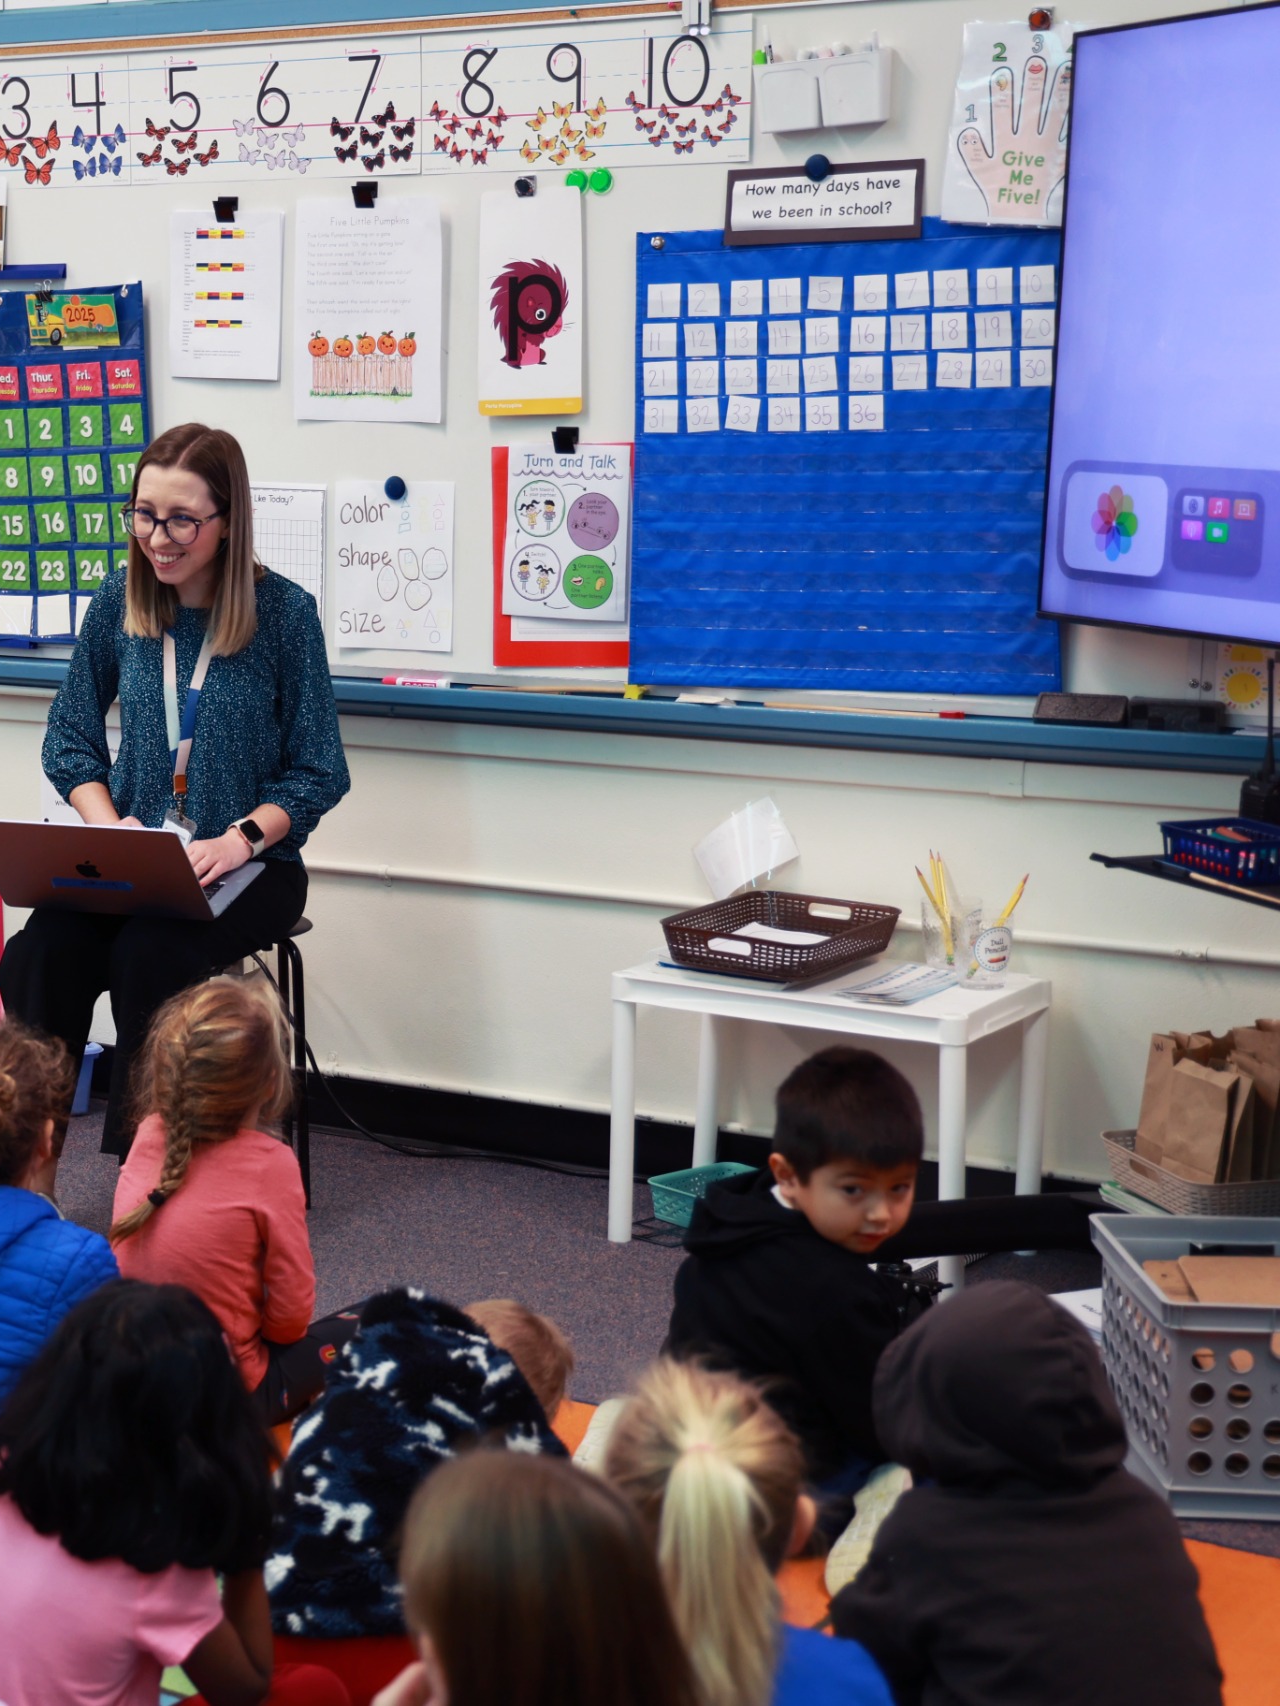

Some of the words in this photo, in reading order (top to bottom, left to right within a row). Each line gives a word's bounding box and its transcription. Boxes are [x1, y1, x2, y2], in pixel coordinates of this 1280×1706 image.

[992, 42, 1008, 62] 2
[1032, 34, 1044, 54] 3
[461, 47, 499, 118] 8
[546, 43, 581, 113] 9
[647, 35, 710, 109] 10
[169, 66, 201, 132] 5
[256, 61, 290, 128] 6
[348, 54, 381, 124] 7
[1, 76, 30, 140] 3
[71, 71, 106, 136] 4
[965, 104, 978, 123] 1
[1001, 150, 1045, 167] Give
[746, 183, 776, 196] How
[782, 184, 820, 197] many
[826, 180, 860, 195] days
[866, 177, 901, 191] have
[1009, 169, 1034, 186] Me
[997, 188, 1041, 205] Five!
[752, 209, 772, 219] we
[778, 206, 813, 218] been
[820, 204, 832, 217] in
[838, 201, 892, 216] school?
[330, 216, 347, 226] Five
[350, 216, 371, 226] Little
[374, 215, 410, 228] Pumpkins
[66, 307, 96, 323] 2025
[508, 274, 562, 361] p
[857, 324, 874, 344] 16
[899, 321, 919, 344] 17
[941, 318, 958, 341] 18
[983, 316, 1000, 338] 19
[649, 332, 660, 351] 11
[31, 372, 53, 383] Thur.
[76, 370, 91, 381] Fri.
[115, 368, 132, 379] Sat.
[649, 369, 665, 387] 21
[1025, 359, 1046, 379] 30
[32, 385, 58, 395] Thursday
[75, 384, 93, 393] Friday
[111, 381, 136, 390] Saturday
[648, 407, 664, 428] 31
[691, 405, 713, 426] 32
[730, 403, 752, 424] 33
[774, 405, 793, 425] 34
[811, 404, 832, 425] 35
[852, 403, 877, 424] 36
[4, 419, 14, 440] 1
[39, 419, 52, 440] 2
[80, 416, 93, 437] 3
[120, 414, 134, 436] 4
[524, 453, 553, 469] Turn
[559, 454, 583, 468] and
[588, 455, 616, 470] Talk
[5, 467, 18, 488] 8
[41, 466, 54, 487] 9
[74, 464, 98, 486] 10
[117, 463, 136, 485] 11
[254, 494, 267, 503] Like
[268, 495, 294, 506] Today?
[2, 515, 24, 536] 15
[42, 512, 65, 534] 16
[82, 513, 104, 534] 17
[1, 560, 27, 581] 22
[40, 560, 66, 581] 23
[80, 560, 106, 581] 24
[984, 945, 1008, 955] Pencils
[990, 938, 1004, 946] Dull
